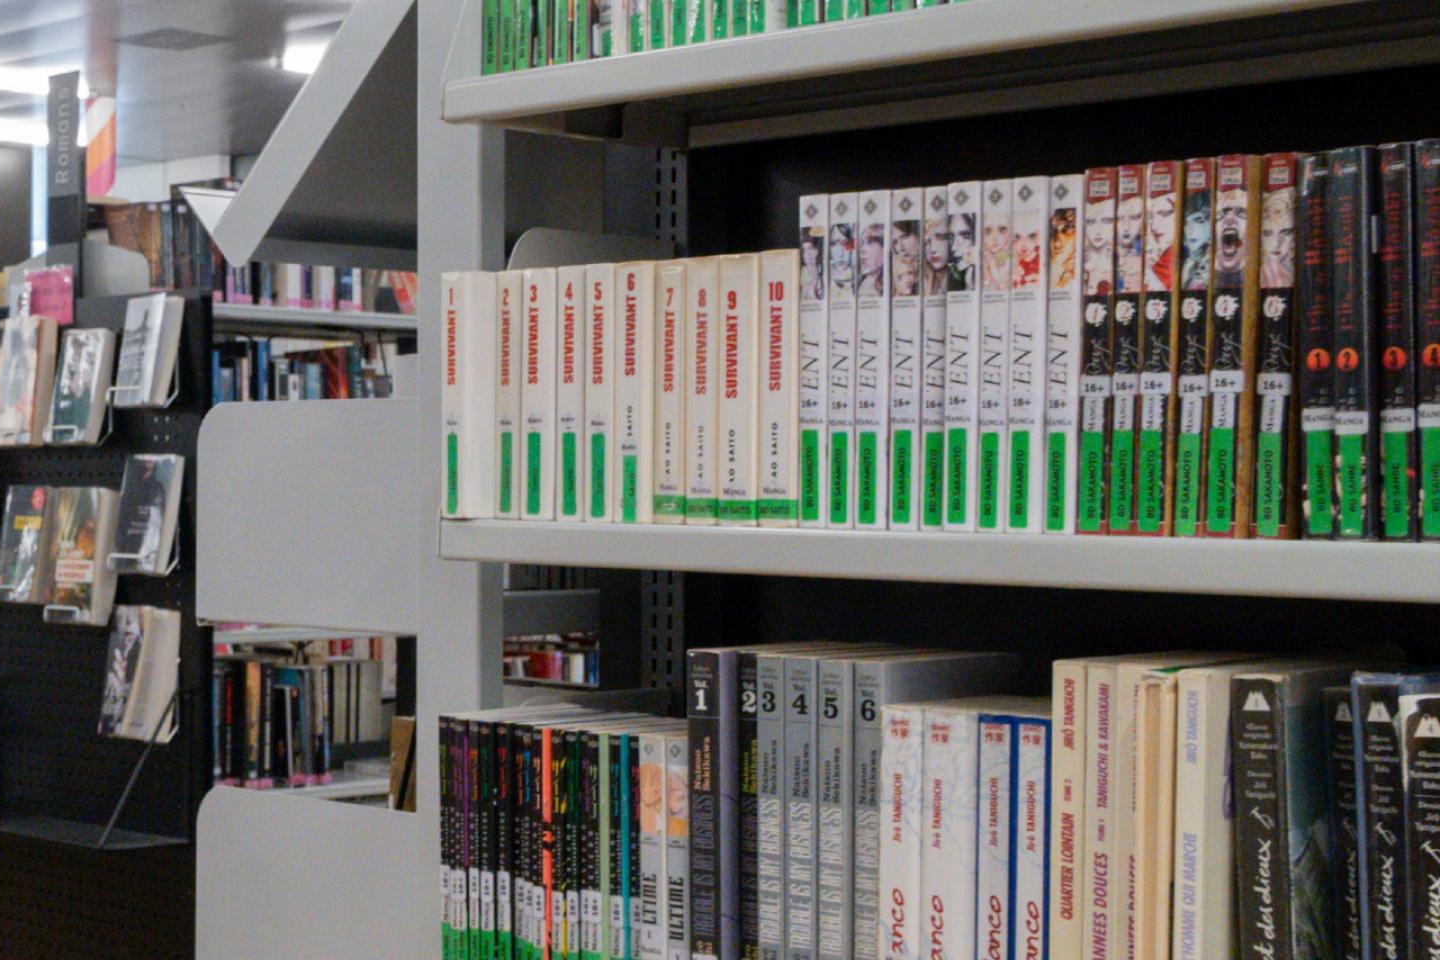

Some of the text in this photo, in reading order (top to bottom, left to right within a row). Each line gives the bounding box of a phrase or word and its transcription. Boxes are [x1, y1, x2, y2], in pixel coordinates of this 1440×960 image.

[55, 88, 70, 184] Romans
[447, 288, 456, 386] SURVIVANT 1
[500, 288, 510, 386] SURVIVANT 2
[528, 284, 539, 384] SURVIVANT 3
[563, 282, 576, 384] SURVIVANT 4
[592, 282, 604, 384] SURVIVANT 5
[624, 272, 637, 376] SURVIVANT 6
[663, 288, 676, 393] SURVIVANT 7
[696, 288, 708, 396] SURVIVANT 8
[726, 290, 739, 400] SURVIVANT 9
[768, 281, 784, 392] SURVIVANT 10
[1084, 383, 1104, 392] 16+
[1116, 381, 1134, 391] 16+
[1144, 380, 1163, 390] 16+
[1182, 383, 1203, 392] 16+
[1215, 378, 1236, 388] 16+
[1263, 380, 1283, 390] 16+
[1316, 352, 1321, 370] 1
[1088, 451, 1098, 519] BD SAKAMOTO
[1118, 450, 1128, 518] BD SAKAMOTO
[1146, 450, 1156, 519] BD SAKAMOTO
[1180, 450, 1192, 520] BD SAKAMOTO
[1216, 450, 1228, 519] BD SAKAMOTO
[1263, 450, 1274, 520] BD SAKAMOTO
[696, 689, 708, 710] 1
[742, 691, 757, 714] 2
[762, 691, 776, 712] 3
[792, 694, 808, 715] 4
[824, 697, 838, 718] 5
[861, 700, 876, 722] 6
[1064, 678, 1074, 726] TANIGUCHI
[1097, 682, 1110, 740] KAWAKAMI
[1186, 690, 1198, 742] TANIGUCHI
[892, 772, 902, 823] TANIGUCHI
[932, 778, 942, 830] TANIGUCHI
[989, 777, 998, 828] TANIGUCHI
[1026, 780, 1036, 832] TANIGUCHI
[1096, 753, 1108, 809] TANIGUCHI
[759, 798, 780, 855] BUSINESS
[789, 801, 812, 859] BUSINESS
[1061, 813, 1074, 920] QUARTIER LOINTAIN
[1093, 852, 1108, 908] DOUCES
[1182, 832, 1197, 906] QUI MARCHE
[1252, 838, 1272, 904] dieux
[1376, 854, 1394, 923] dieux
[642, 872, 656, 926] LTIME
[668, 876, 684, 941] ULTIME
